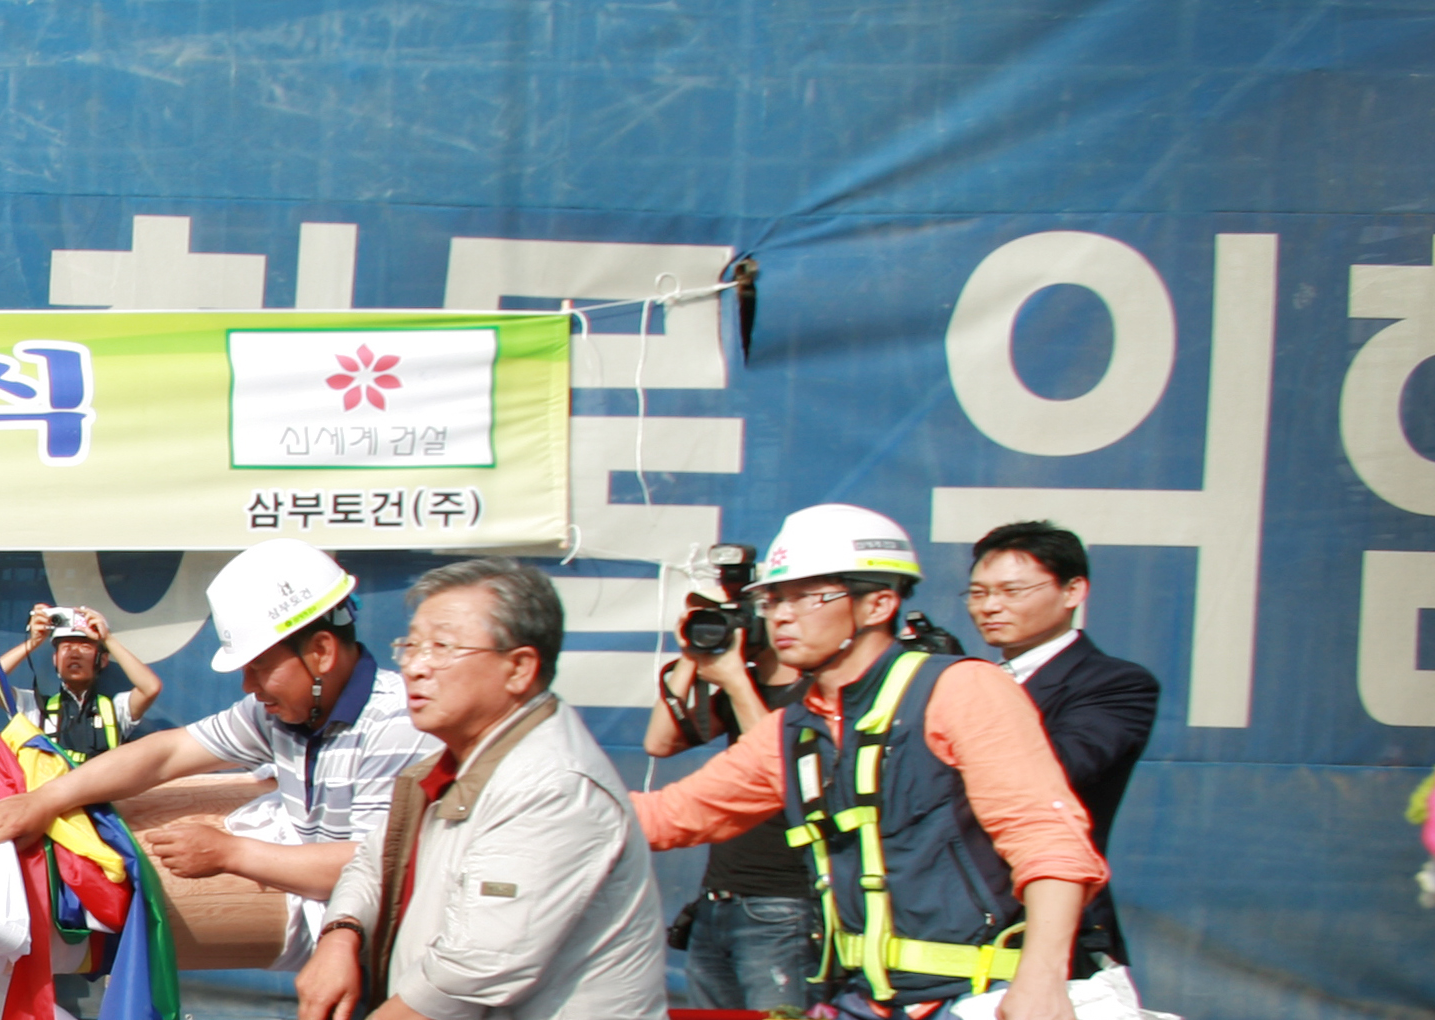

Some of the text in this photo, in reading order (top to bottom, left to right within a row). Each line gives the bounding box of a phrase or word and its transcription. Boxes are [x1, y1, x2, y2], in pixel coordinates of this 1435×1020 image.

[279, 425, 449, 456] 신세계 건설
[930, 231, 1435, 727] 위
[248, 489, 482, 529] 삼부토건(주)
